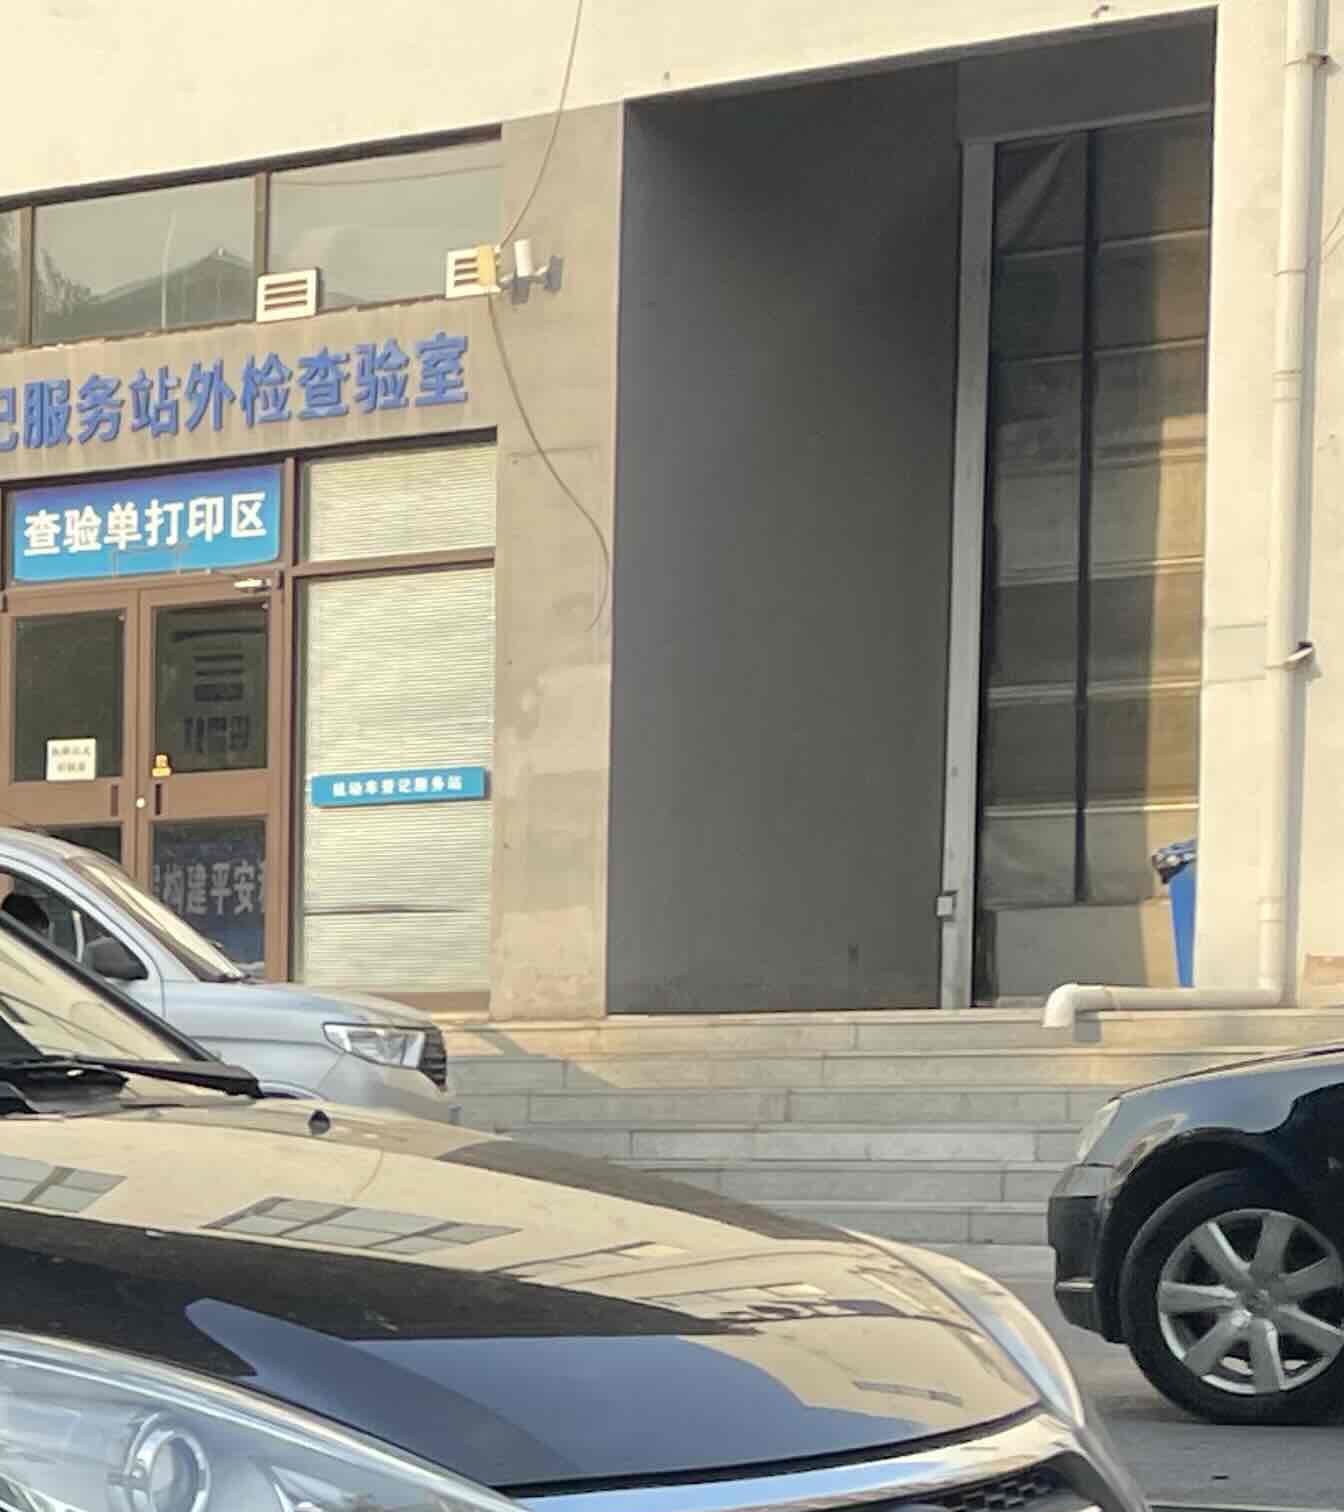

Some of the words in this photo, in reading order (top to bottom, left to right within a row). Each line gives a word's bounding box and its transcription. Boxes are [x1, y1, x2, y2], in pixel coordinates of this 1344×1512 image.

[23, 491, 267, 557] 查验单打印区
[153, 859, 265, 915] 构建平安
